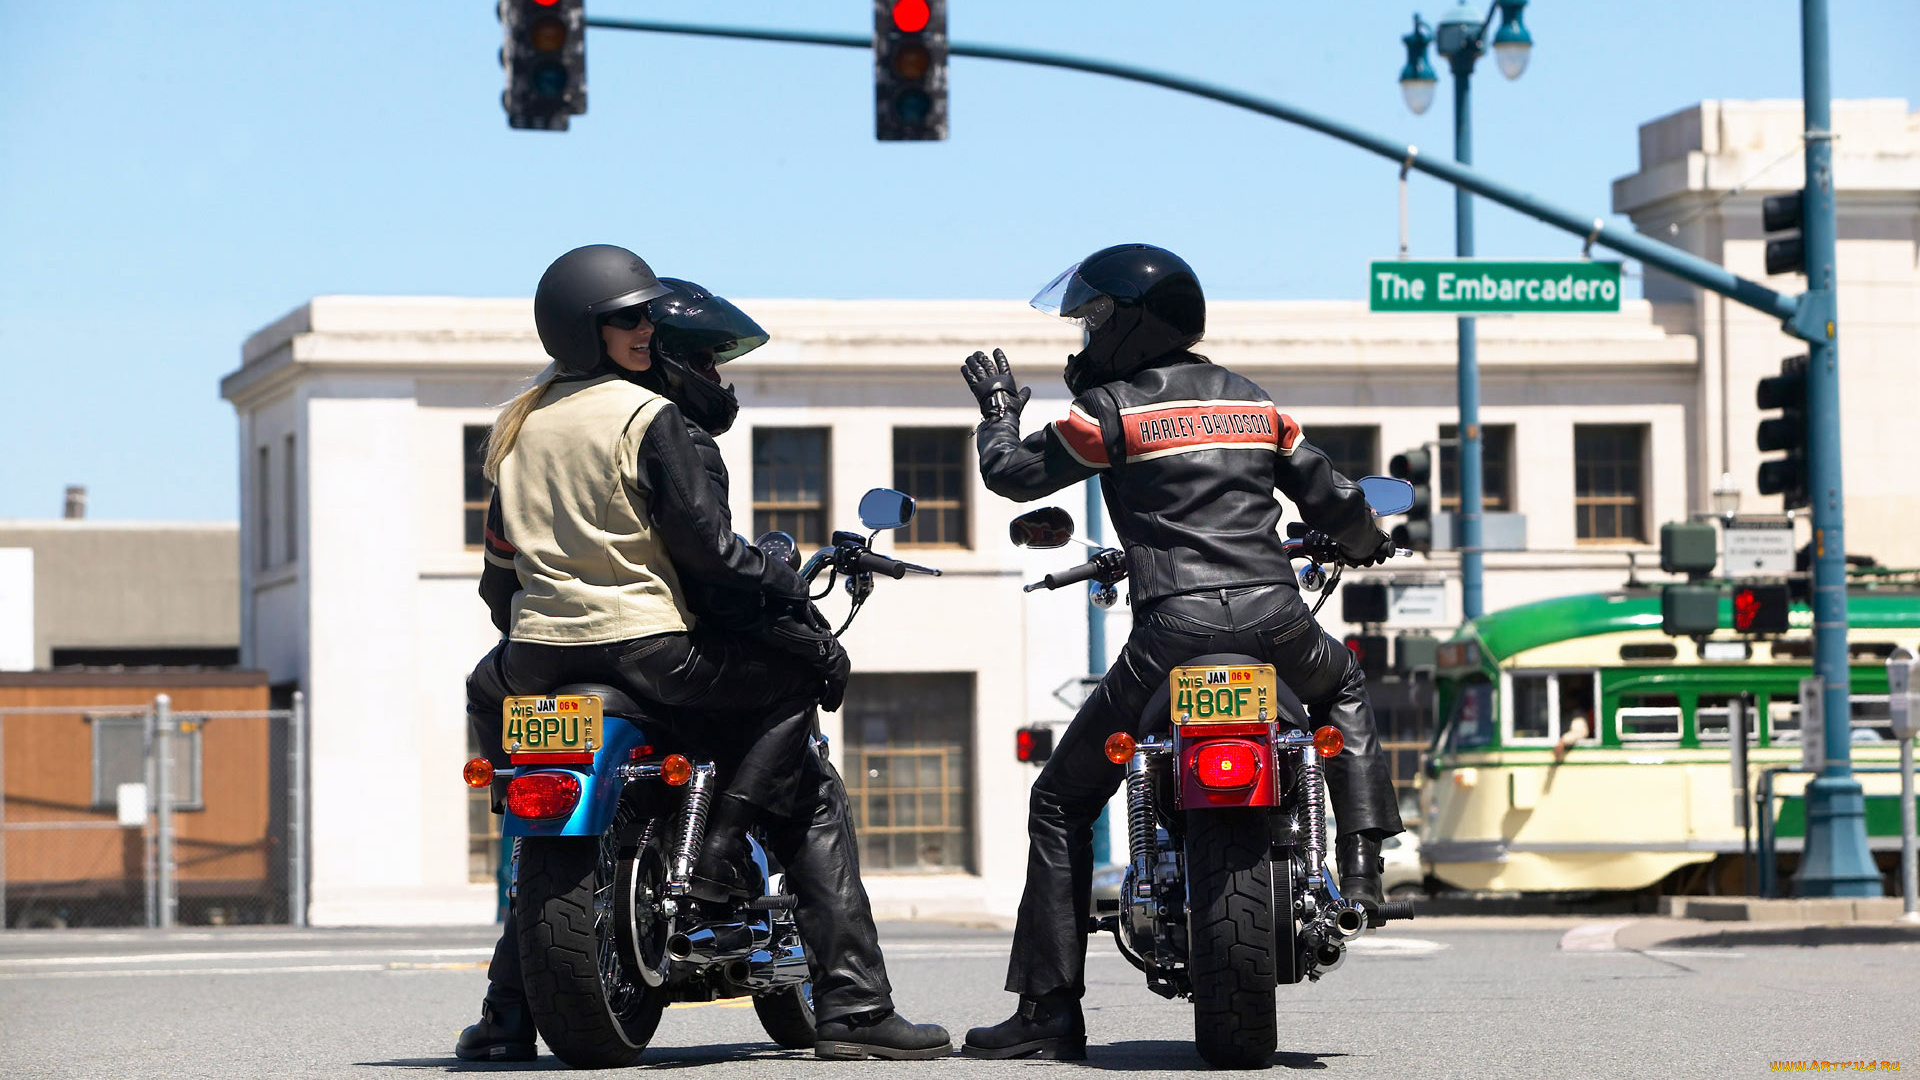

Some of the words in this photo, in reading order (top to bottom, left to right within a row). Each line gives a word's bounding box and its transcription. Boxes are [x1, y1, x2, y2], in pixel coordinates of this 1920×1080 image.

[1376, 272, 1426, 301] The
[1437, 272, 1616, 301] Embarcadero
[1138, 413, 1273, 444] HARLEY-DAVIDSON
[1178, 676, 1203, 688] WIS
[1207, 672, 1226, 684] JAN
[1231, 672, 1242, 681] 06
[511, 705, 534, 717] WIS
[537, 700, 555, 712] JAN
[559, 701, 570, 710] 06
[1177, 687, 1252, 717] 48QF
[507, 716, 579, 747] 48PU
